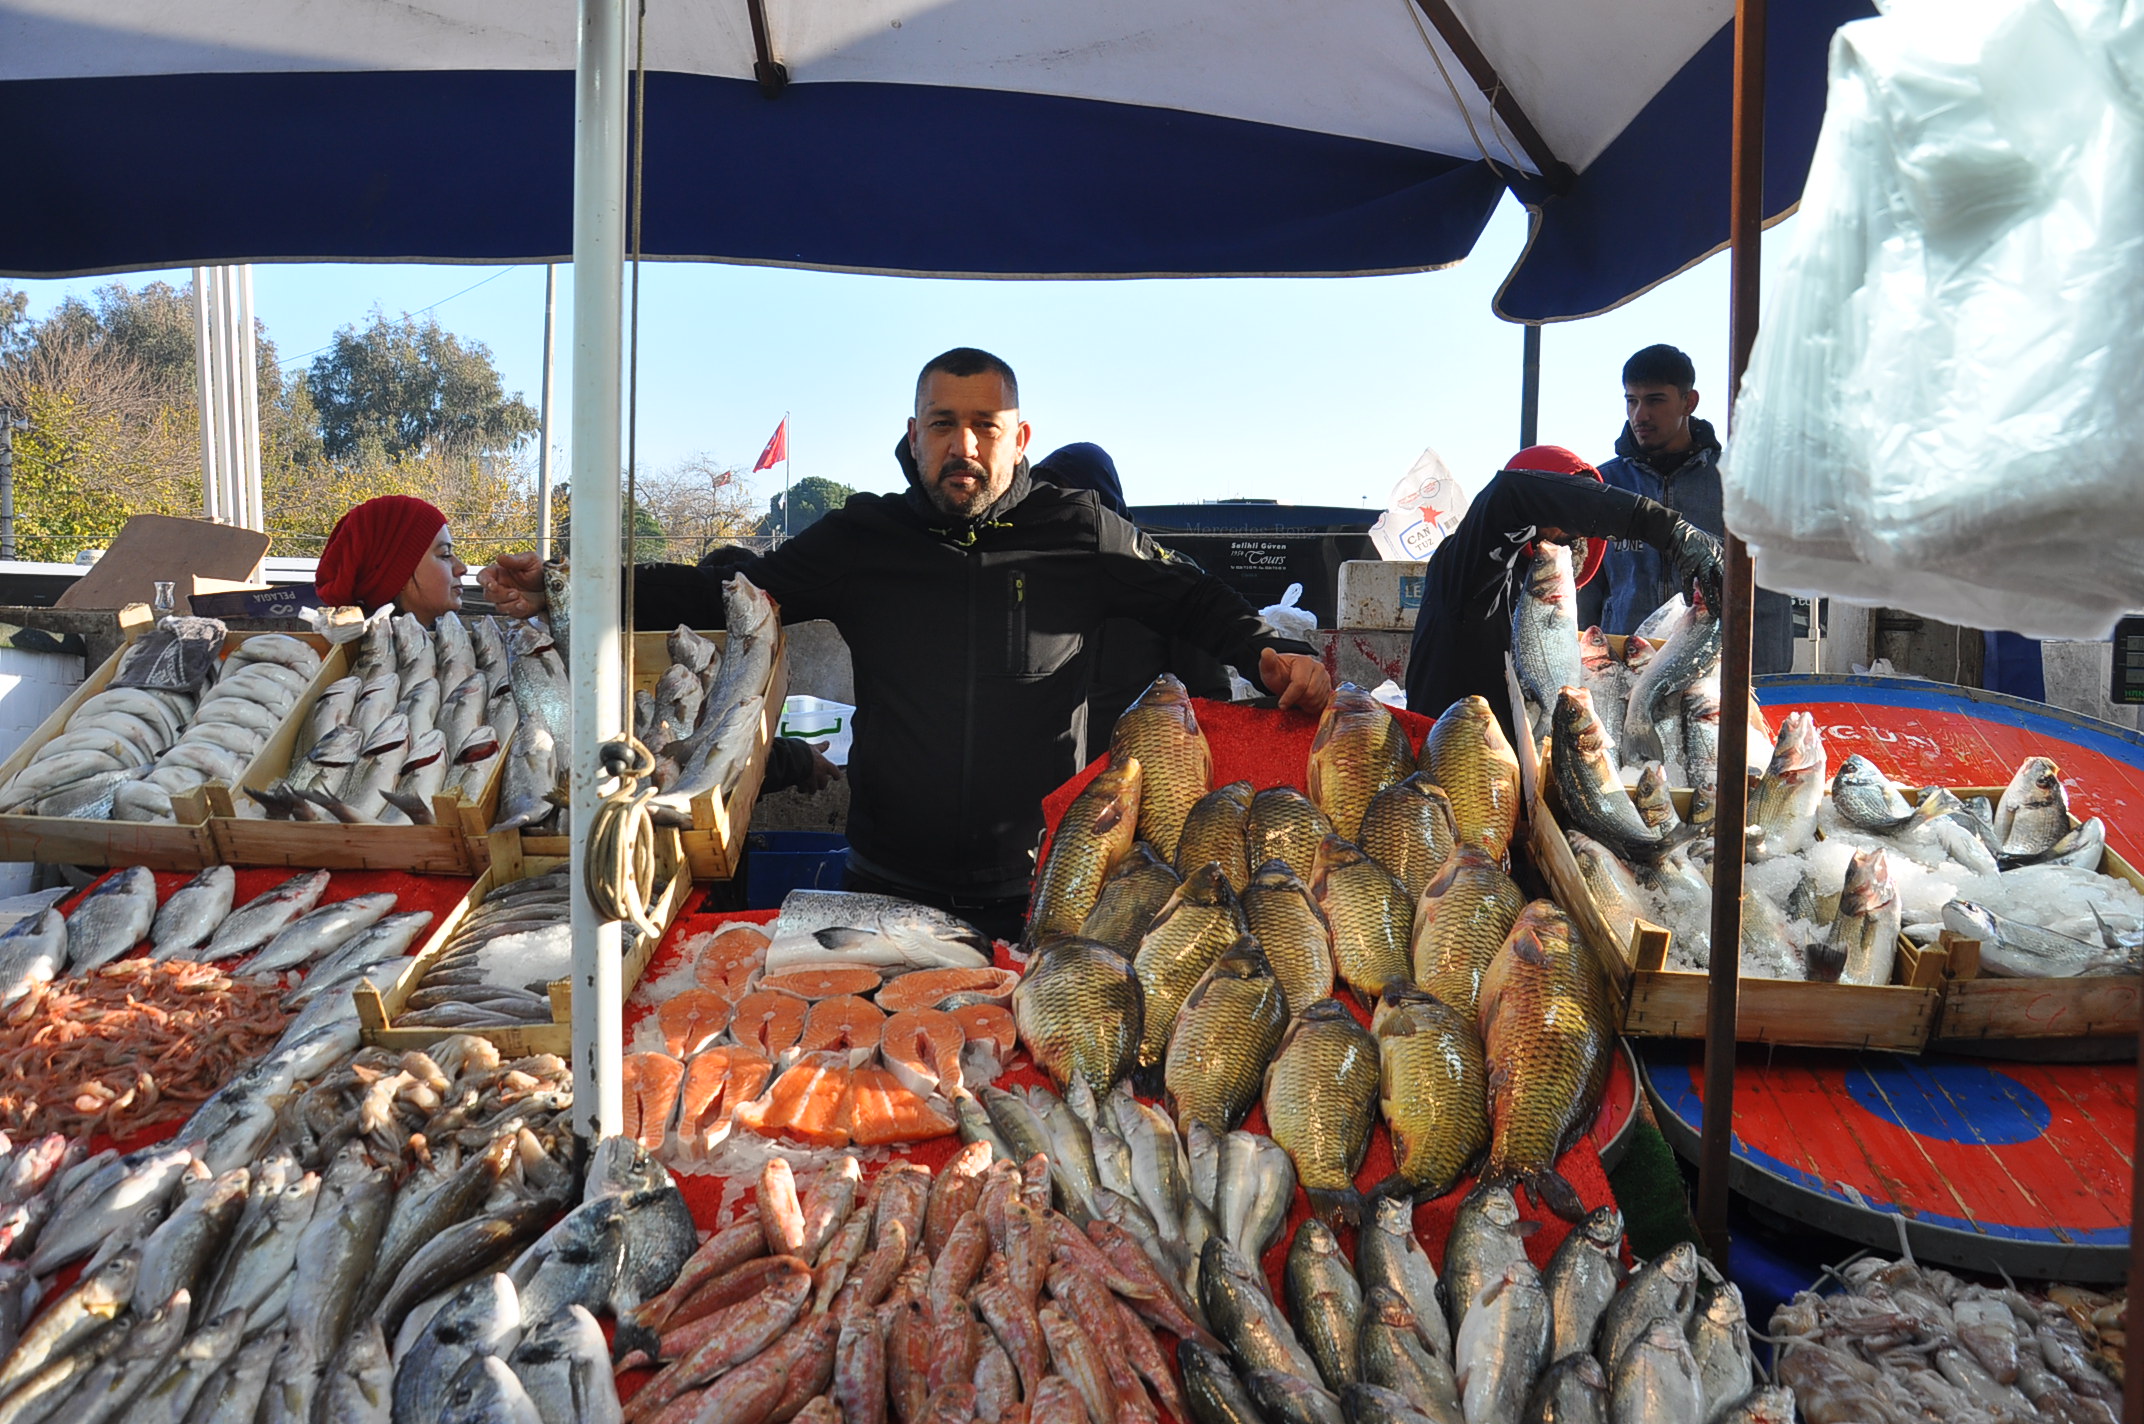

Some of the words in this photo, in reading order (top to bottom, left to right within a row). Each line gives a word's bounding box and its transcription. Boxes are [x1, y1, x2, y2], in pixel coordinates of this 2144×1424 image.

[1407, 526, 1431, 545] CAN
[1415, 538, 1434, 552] TUZ
[1613, 538, 1644, 552] ZONE
[1245, 550, 1286, 565] Tours
[253, 591, 296, 602] PELAGIA
